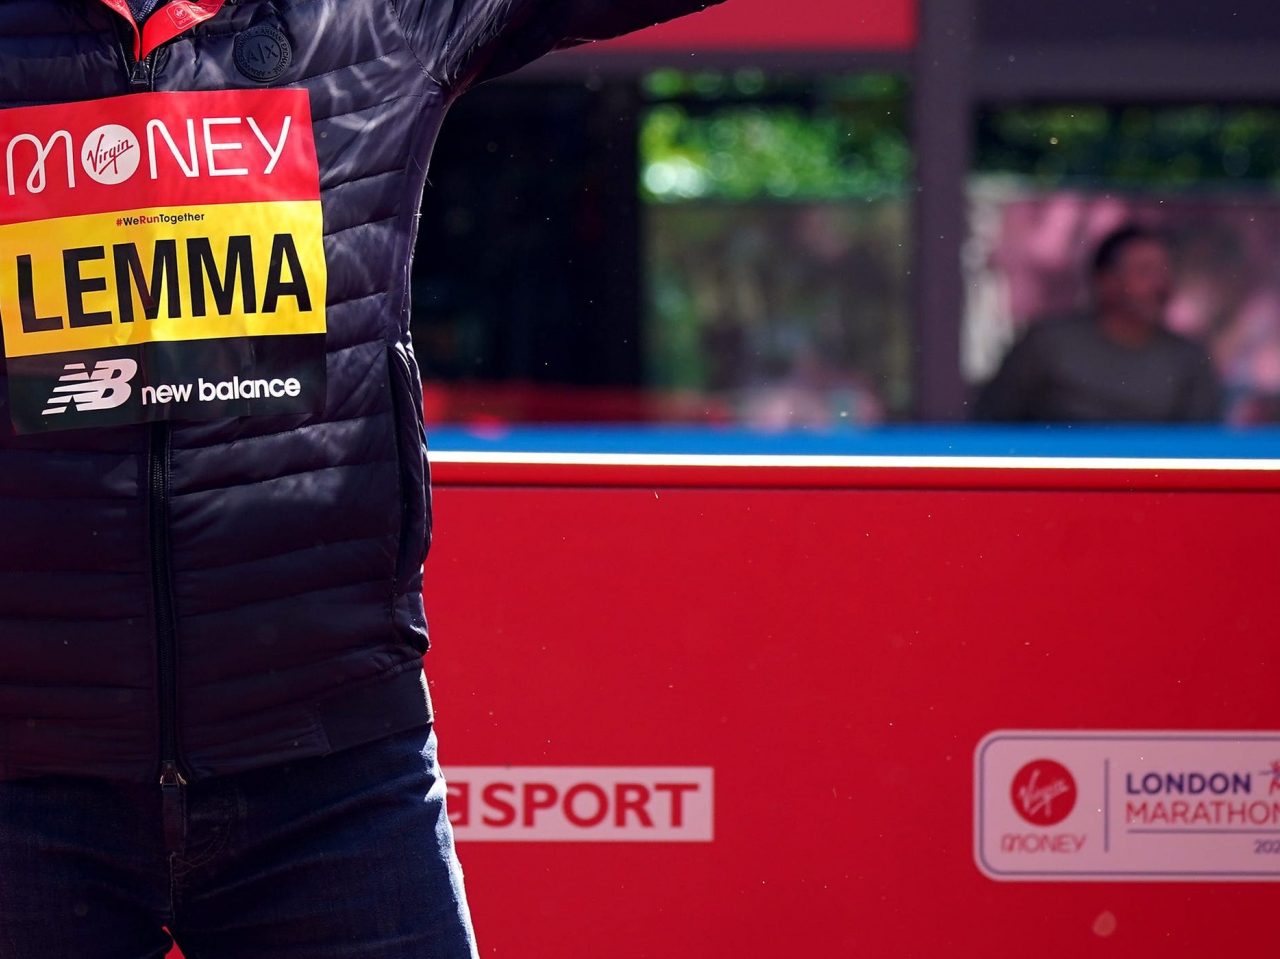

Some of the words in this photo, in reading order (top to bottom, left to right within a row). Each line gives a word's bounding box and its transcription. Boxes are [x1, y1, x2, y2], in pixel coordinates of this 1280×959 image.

[6, 116, 291, 195] MONEY
[86, 133, 134, 176] Virgin
[116, 212, 205, 227] #WeRunTogether
[16, 233, 312, 333] LEMMA
[141, 382, 193, 406] new
[198, 376, 301, 402] balance
[1125, 772, 1252, 795] LONDON
[481, 783, 699, 828] SPORT
[1000, 833, 1087, 854] MONEY
